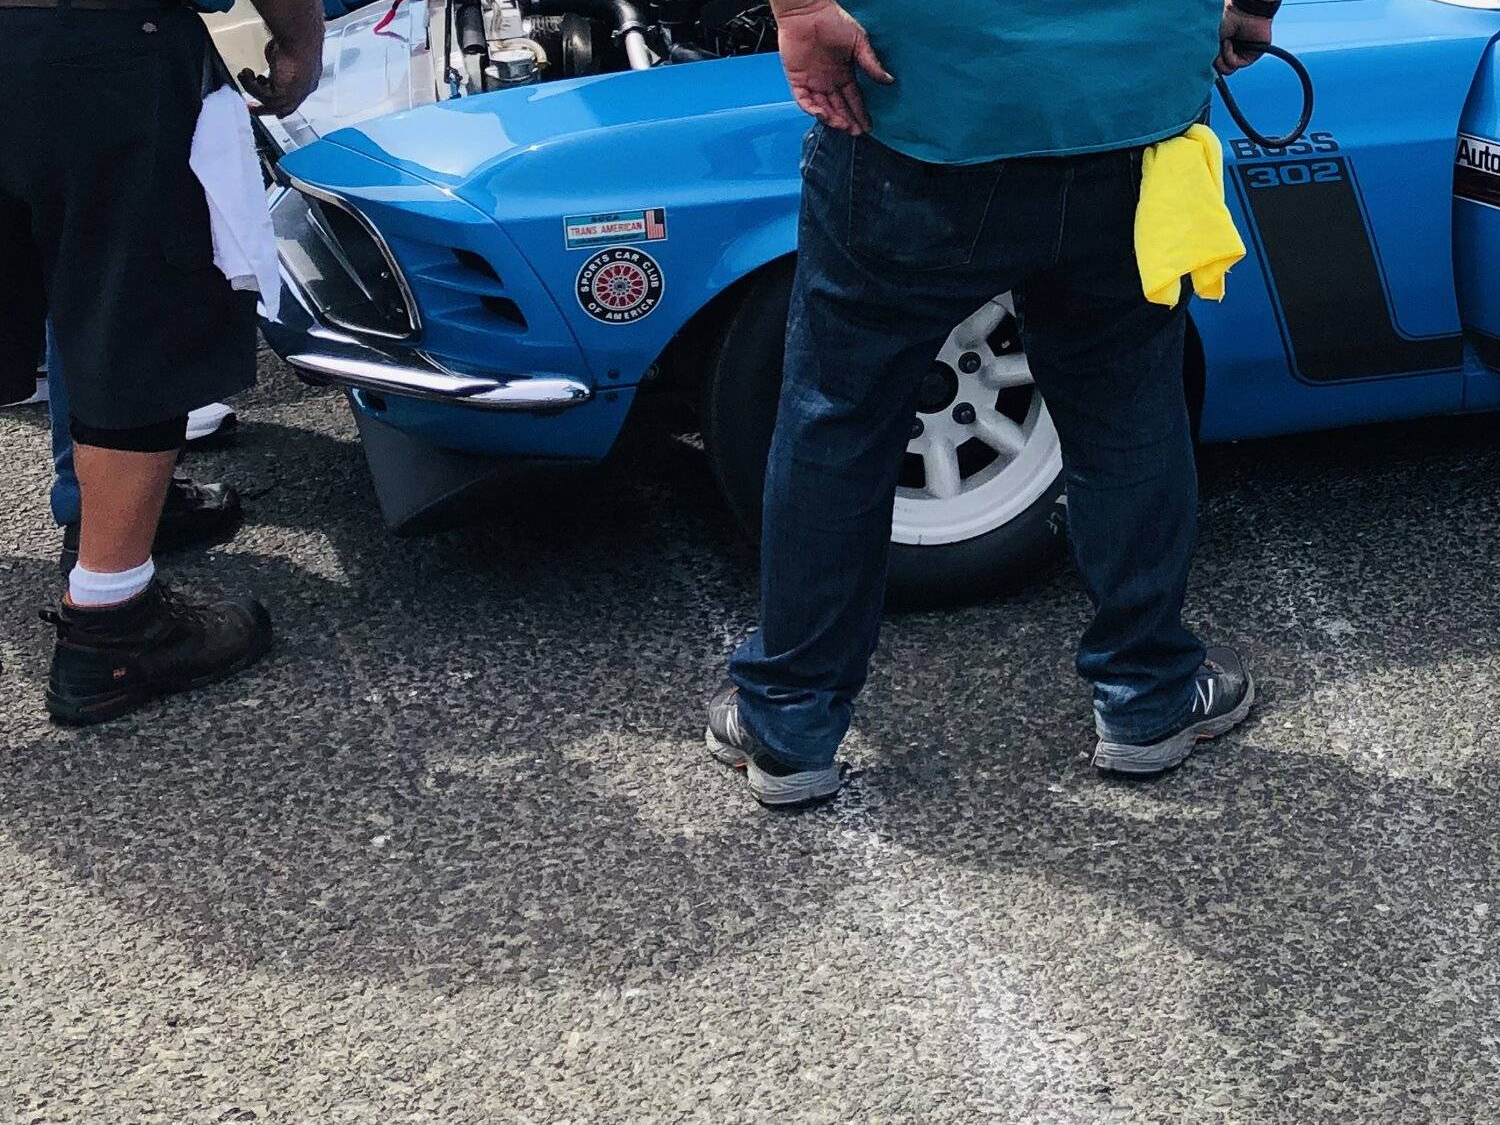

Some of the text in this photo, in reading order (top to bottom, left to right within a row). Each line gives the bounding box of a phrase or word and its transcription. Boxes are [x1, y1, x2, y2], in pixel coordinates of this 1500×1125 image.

[1246, 162, 1343, 188] 302
[570, 221, 643, 237] TRANS AMERICAN
[580, 251, 660, 293] SPORTS CAR CLUB
[588, 298, 655, 320] OF AMERICA
